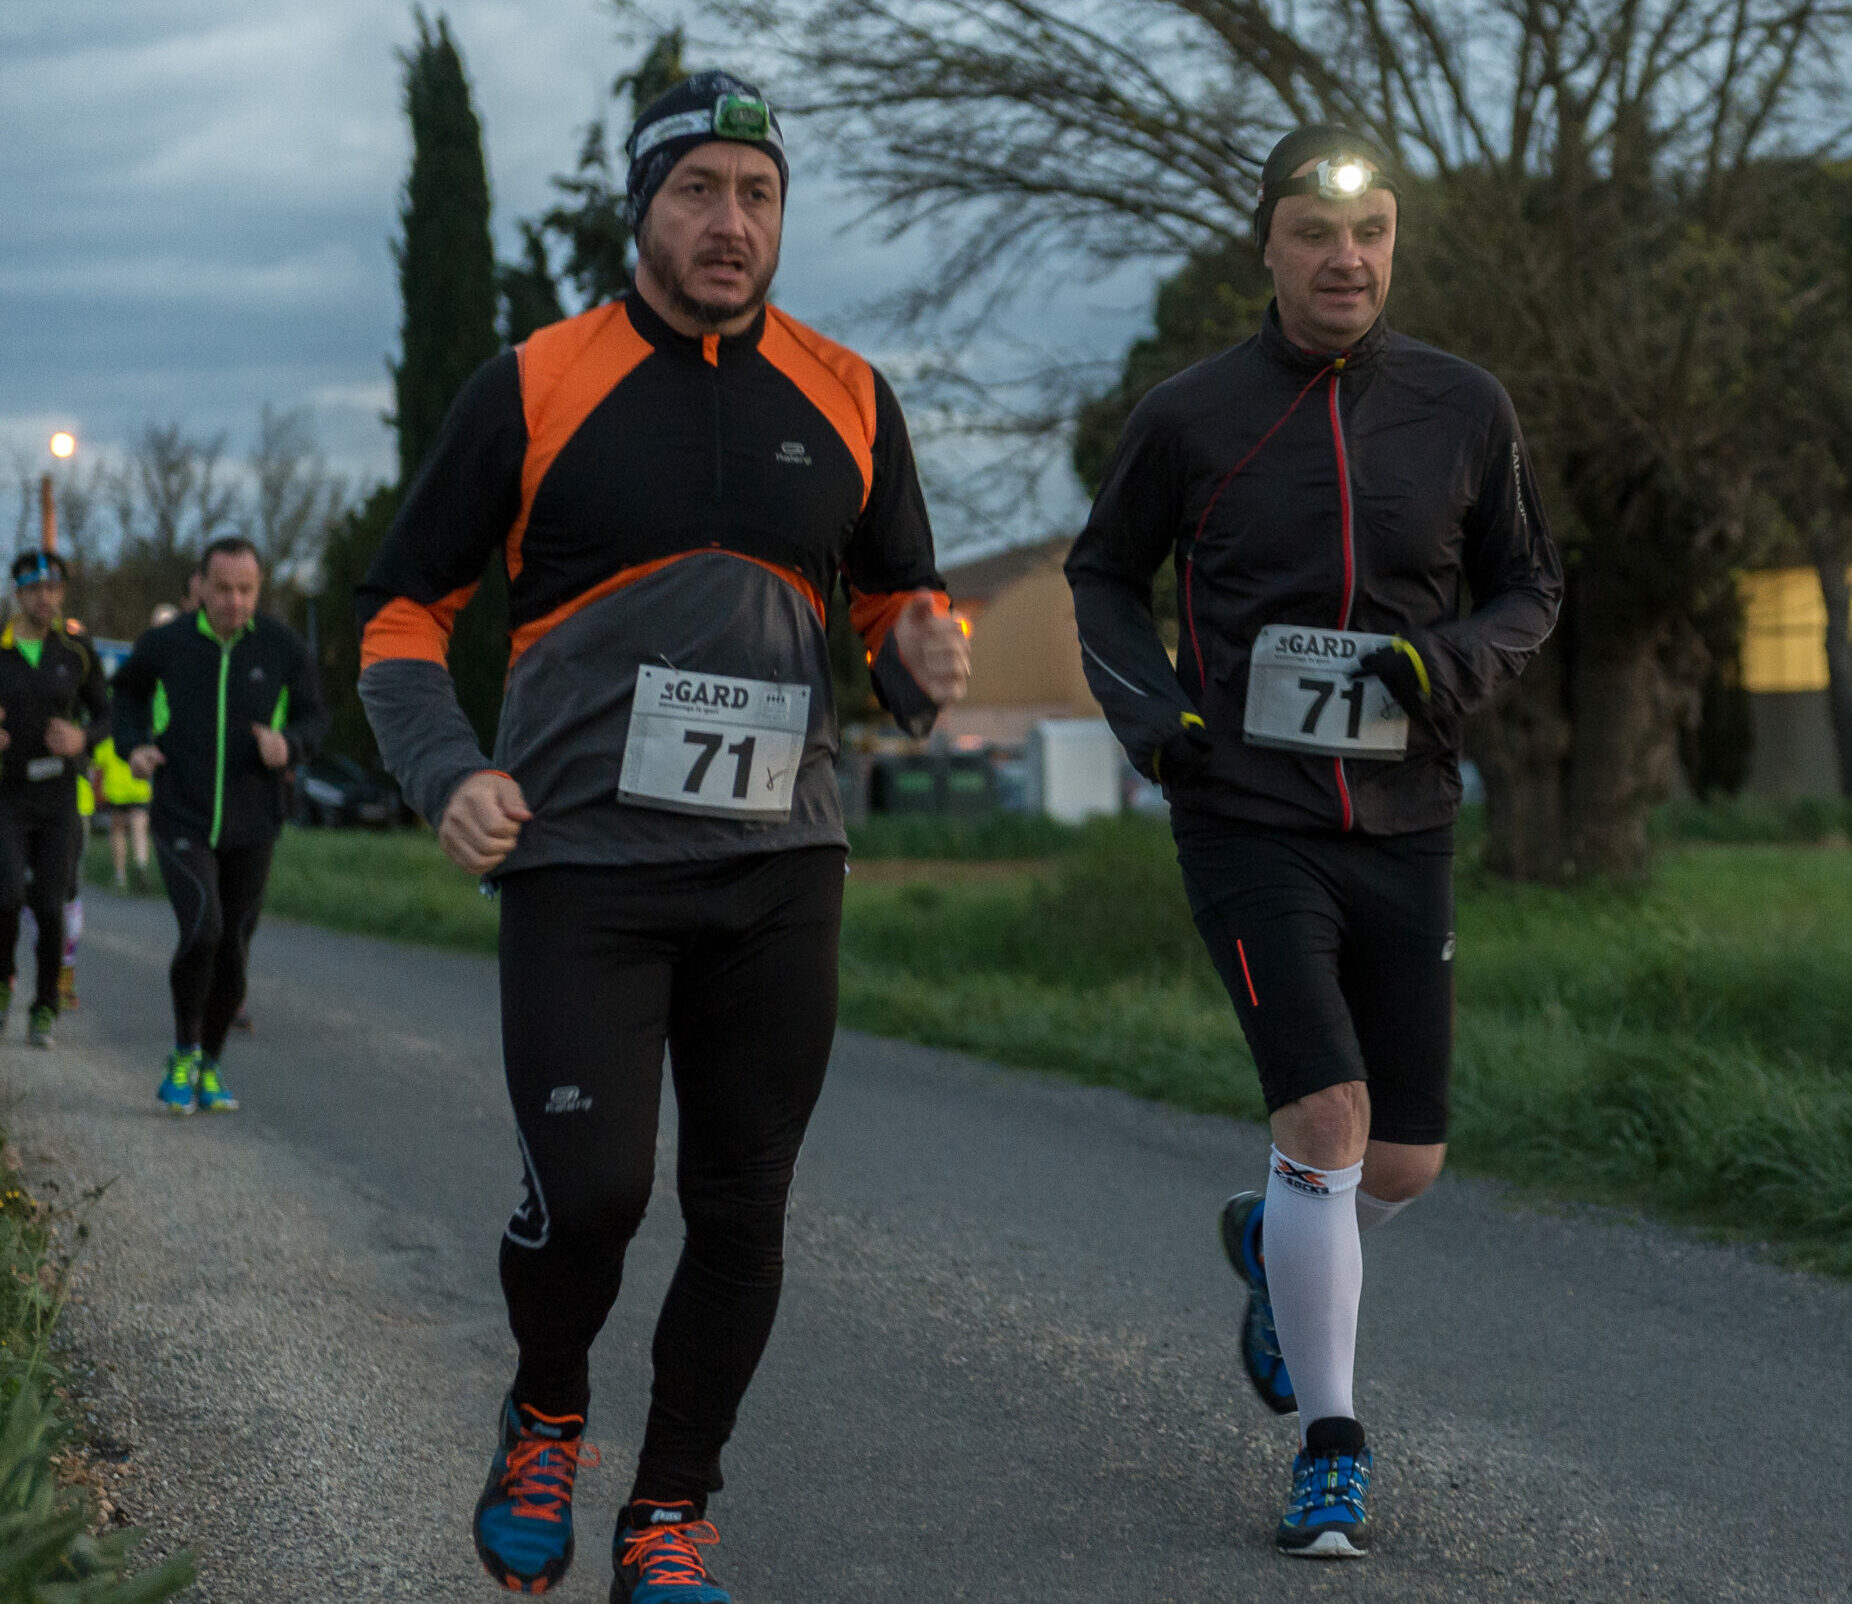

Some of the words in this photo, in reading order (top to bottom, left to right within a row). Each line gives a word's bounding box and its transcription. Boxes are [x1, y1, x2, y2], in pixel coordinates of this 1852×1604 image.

[1289, 634, 1356, 658] GARD
[675, 680, 749, 709] GARD
[1299, 678, 1364, 739] 71
[683, 730, 756, 799] 71
